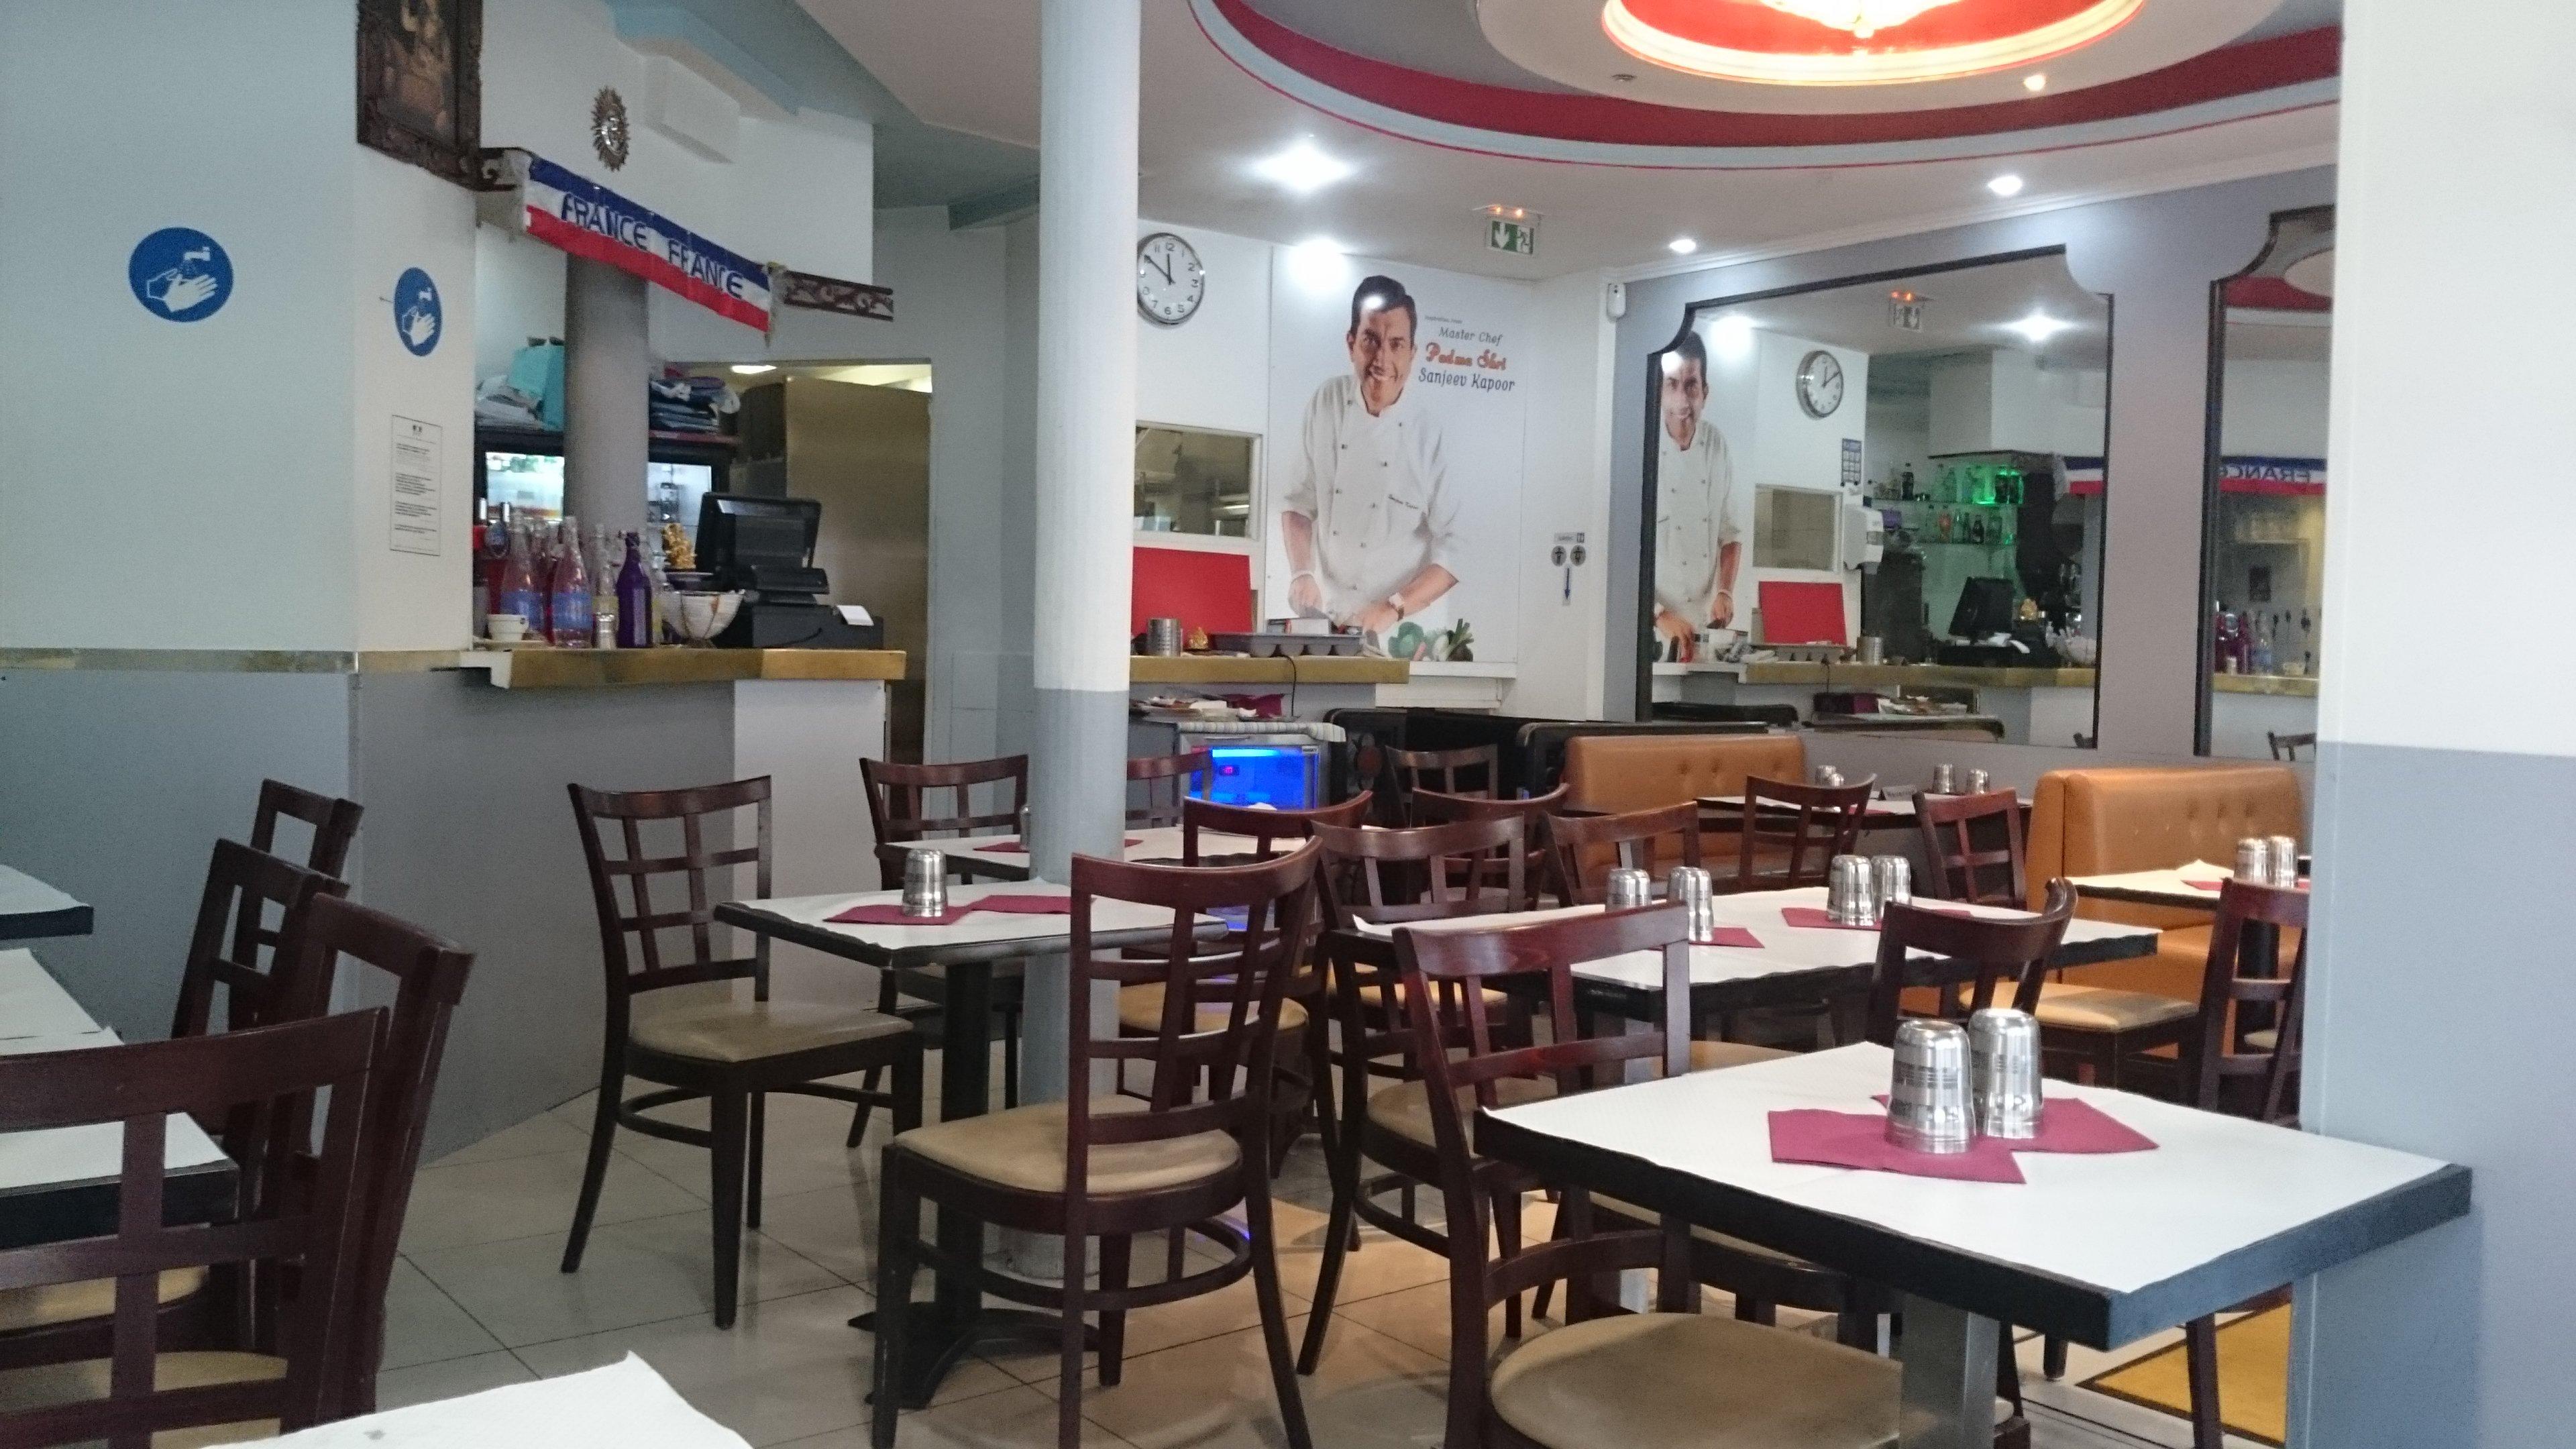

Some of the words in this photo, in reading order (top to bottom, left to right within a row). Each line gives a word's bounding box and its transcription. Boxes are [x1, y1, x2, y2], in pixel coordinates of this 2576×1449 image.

[561, 193, 647, 251] FRANCE
[1187, 262, 1195, 272] 2
[1191, 278, 1199, 288] 3
[1164, 307, 1171, 315] 6
[1438, 327, 1476, 341] Master
[1479, 331, 1503, 346] Chef
[1418, 367, 1467, 388] Sanjeev
[1471, 373, 1515, 392] Kapoor
